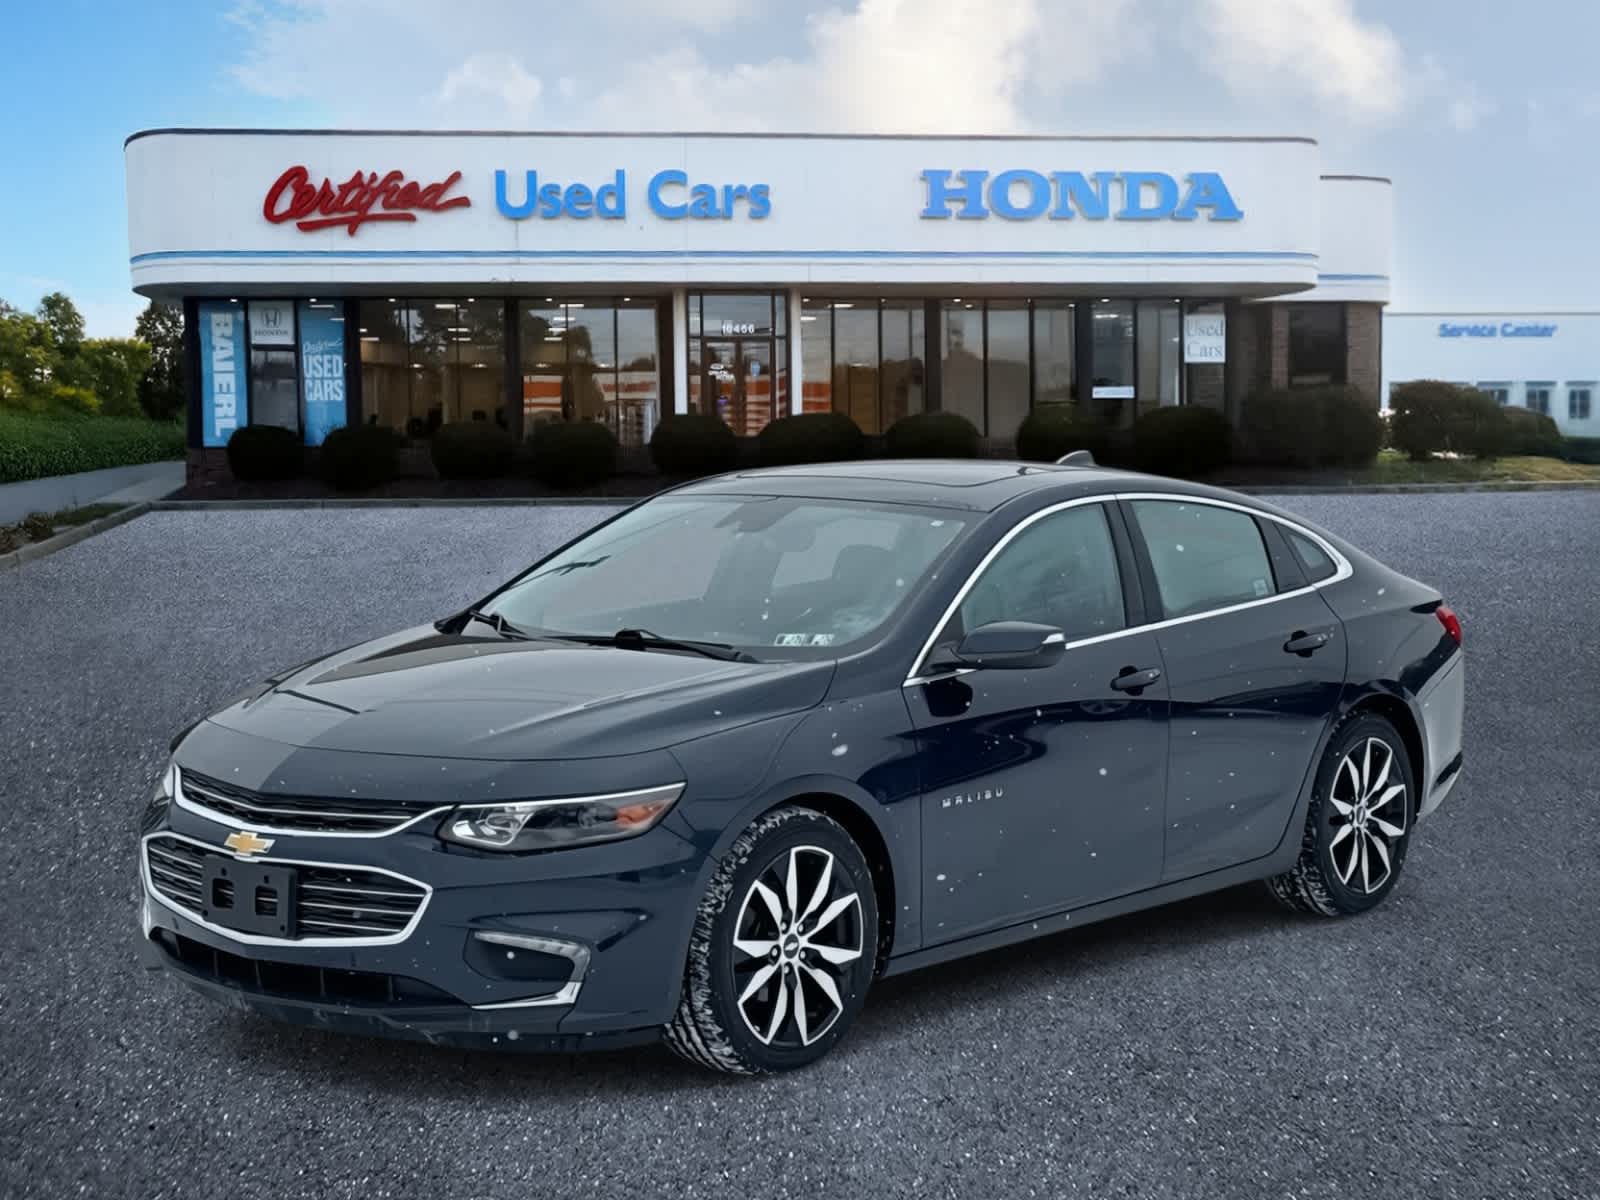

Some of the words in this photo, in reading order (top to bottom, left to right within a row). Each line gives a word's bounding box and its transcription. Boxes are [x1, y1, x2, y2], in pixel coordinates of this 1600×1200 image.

[263, 165, 471, 236] Certified
[495, 169, 625, 220] Used
[648, 169, 771, 220] Cars
[920, 169, 1244, 221] HONDA
[1186, 318, 1224, 337] Used
[1186, 342, 1223, 358] Cars
[211, 312, 236, 437] BAIERL
[303, 354, 342, 378] USED
[304, 379, 343, 401] CARS
